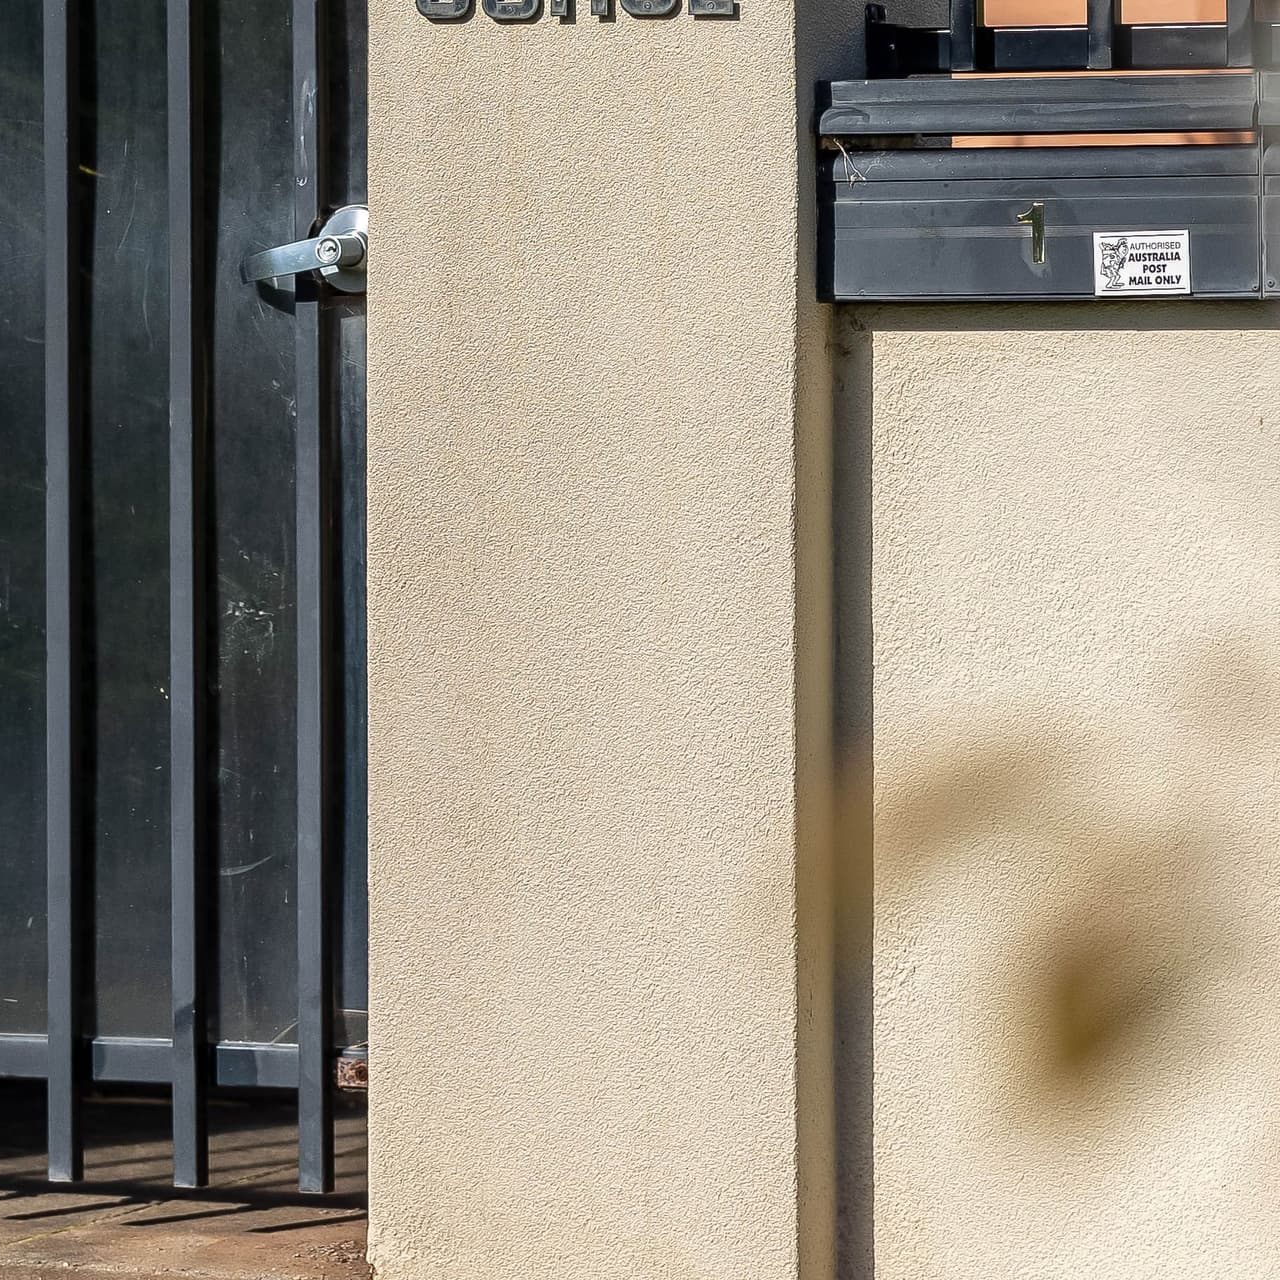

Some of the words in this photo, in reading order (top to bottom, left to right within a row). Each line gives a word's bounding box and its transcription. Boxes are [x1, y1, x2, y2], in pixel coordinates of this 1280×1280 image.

[1017, 202, 1046, 264] 1
[1129, 241, 1181, 251] AUTHORISED
[1128, 251, 1181, 263] AUSTRALIA
[1142, 263, 1168, 274] POST
[1128, 276, 1153, 286] MAIL
[1154, 275, 1182, 286] ONLY
